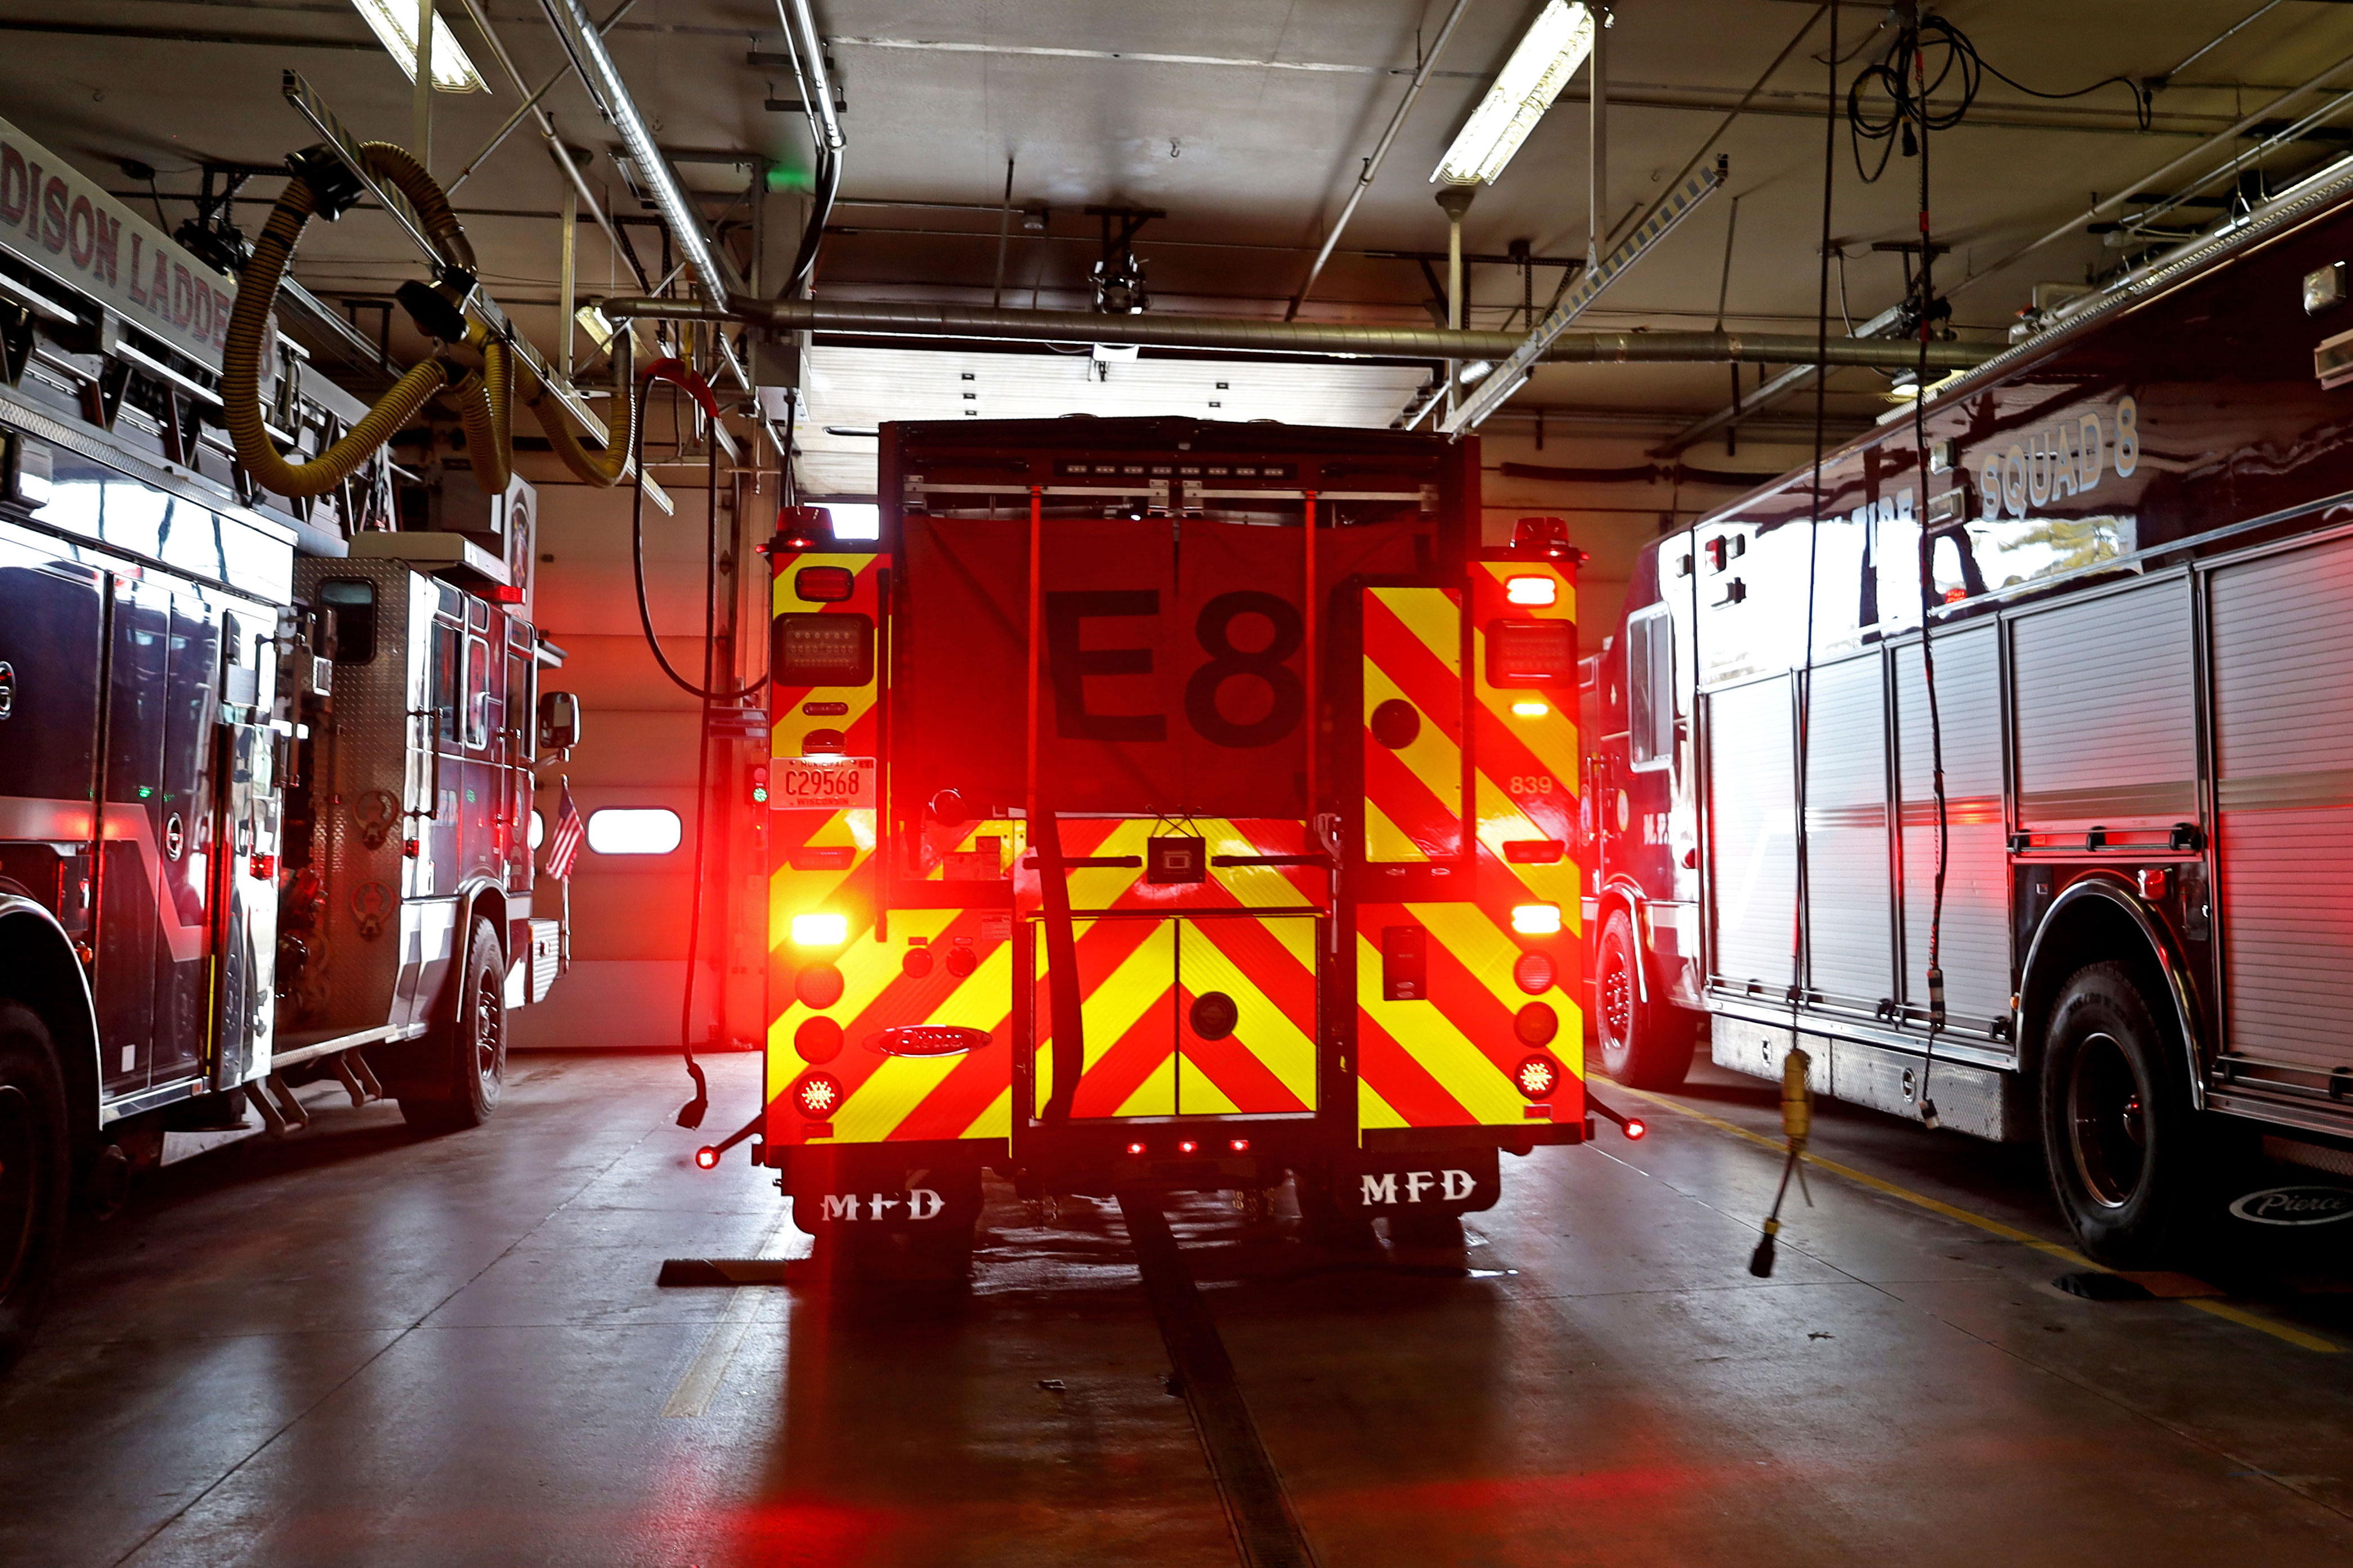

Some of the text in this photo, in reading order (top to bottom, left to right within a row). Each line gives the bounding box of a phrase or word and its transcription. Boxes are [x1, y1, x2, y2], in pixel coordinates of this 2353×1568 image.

[127, 232, 230, 356] LADDE
[1980, 395, 2139, 522] SQUAD 8
[1046, 589, 1305, 749] E8
[786, 770, 859, 795] C29568
[1510, 776, 1552, 794] 839
[1359, 1170, 1477, 1206] MFD
[2257, 1193, 2346, 1216] Pierce
